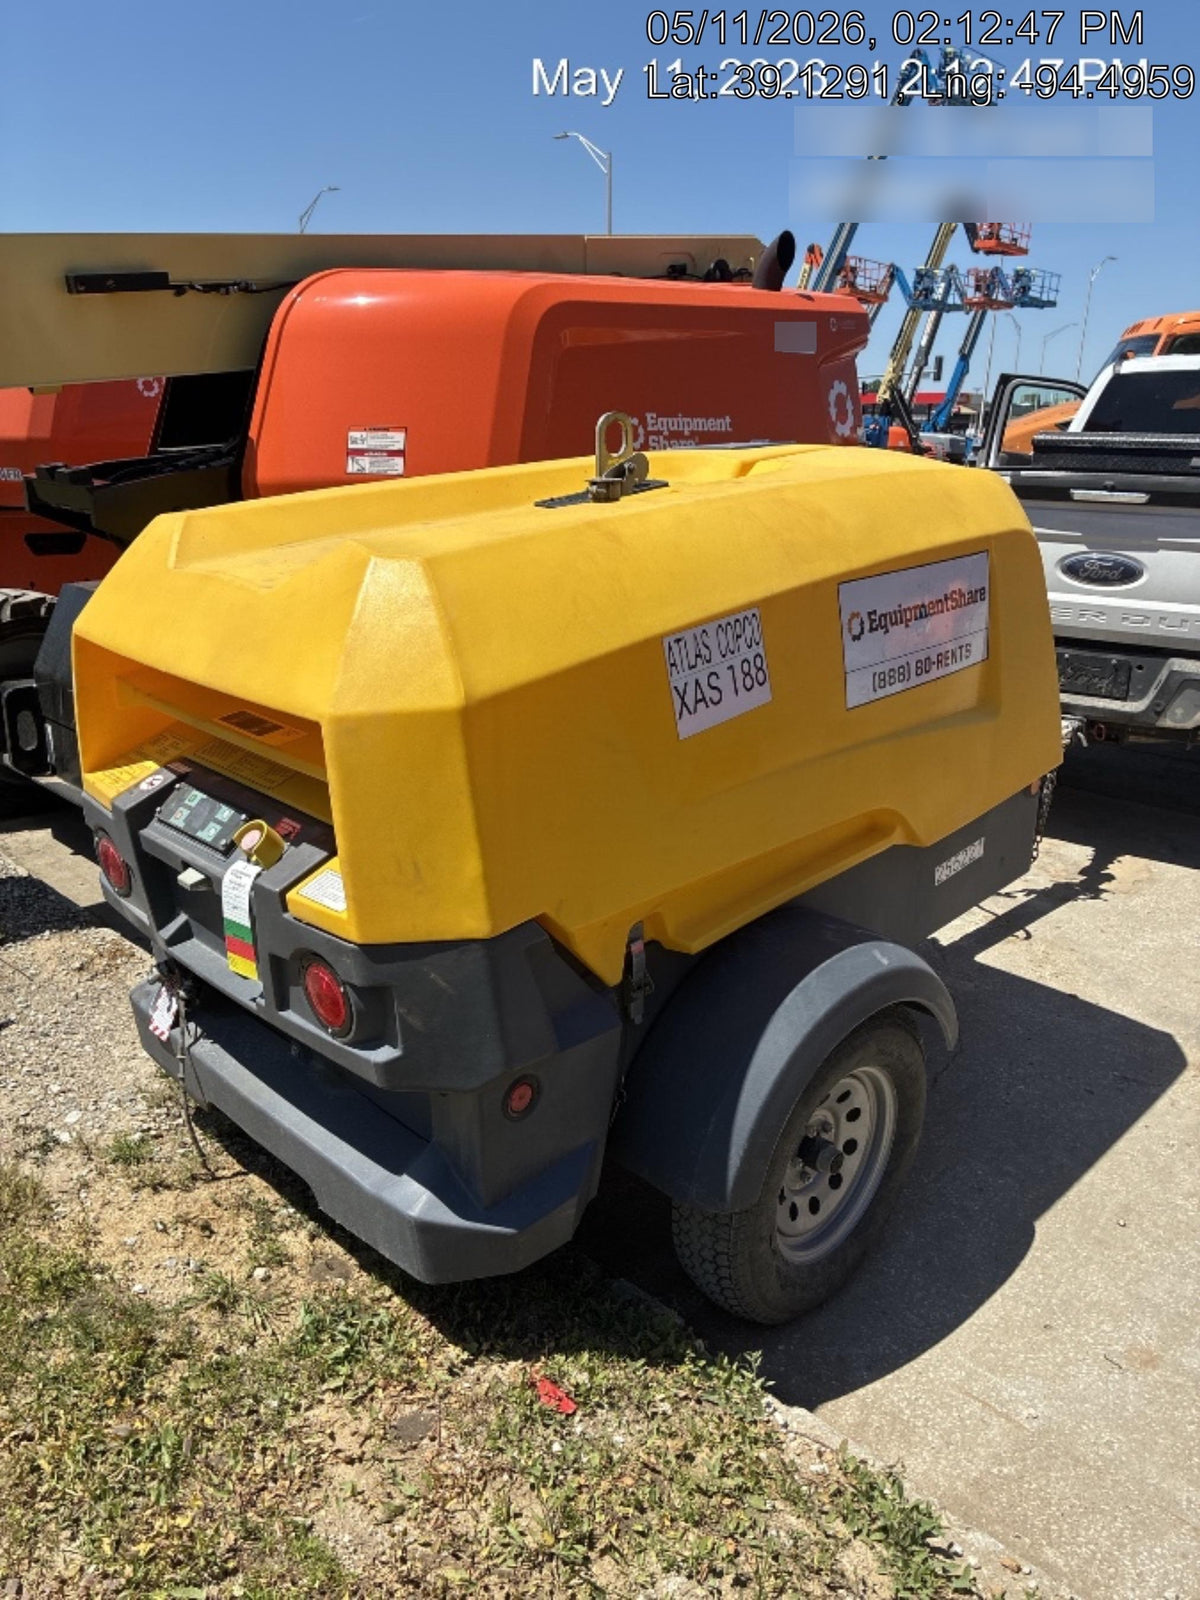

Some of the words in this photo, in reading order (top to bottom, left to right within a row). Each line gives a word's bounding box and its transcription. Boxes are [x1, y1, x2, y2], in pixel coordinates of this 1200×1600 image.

[645, 411, 733, 436] Equipment
[1078, 559, 1124, 582] Ford
[867, 584, 987, 635] EquipmentShare
[1121, 612, 1200, 632] DU
[665, 630, 713, 678] ATLAS
[715, 610, 762, 660] COPCO
[871, 659, 912, 694] (888)
[914, 640, 973, 679] 80-RENTS
[673, 669, 723, 721] XAS
[727, 651, 768, 698] 188
